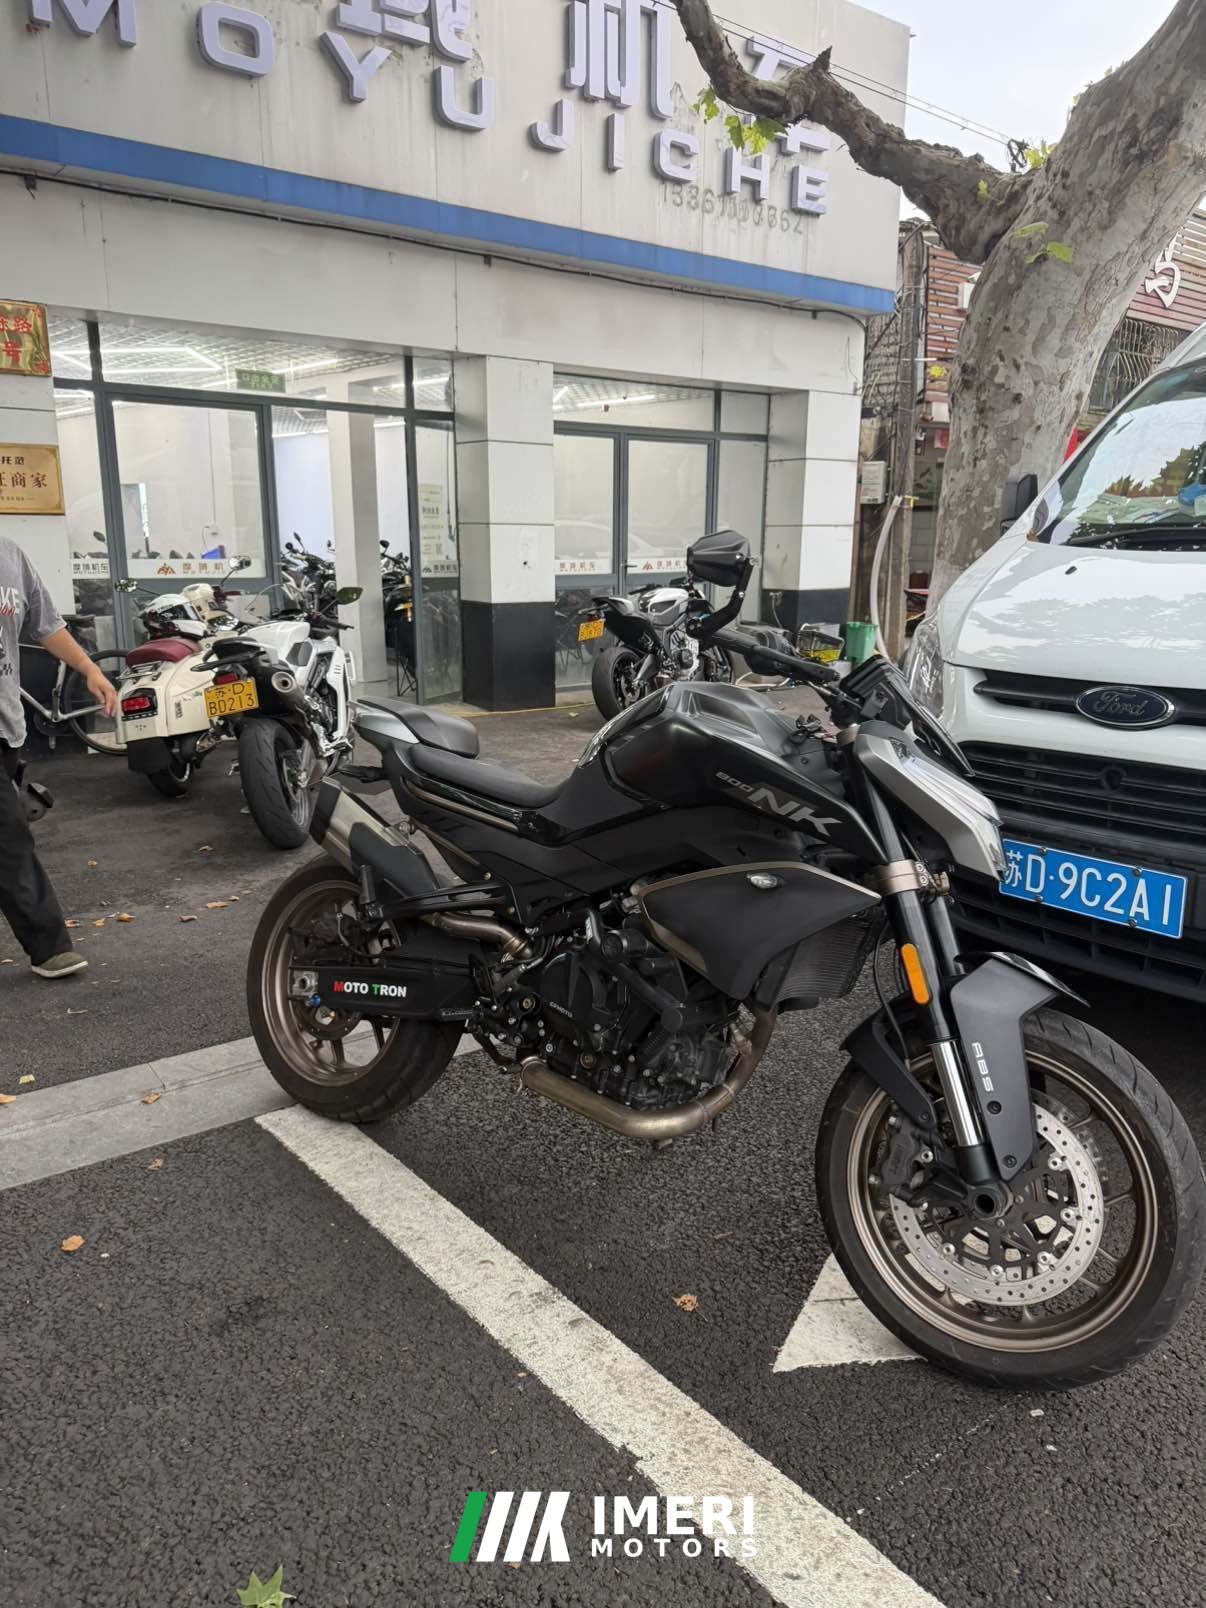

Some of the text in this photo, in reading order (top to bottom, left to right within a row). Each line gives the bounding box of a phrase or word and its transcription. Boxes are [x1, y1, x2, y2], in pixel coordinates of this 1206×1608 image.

[1094, 691, 1148, 717] Ford
[747, 788, 843, 837] NK
[333, 980, 407, 998] MOTO TRON
[971, 1042, 995, 1092] ABS
